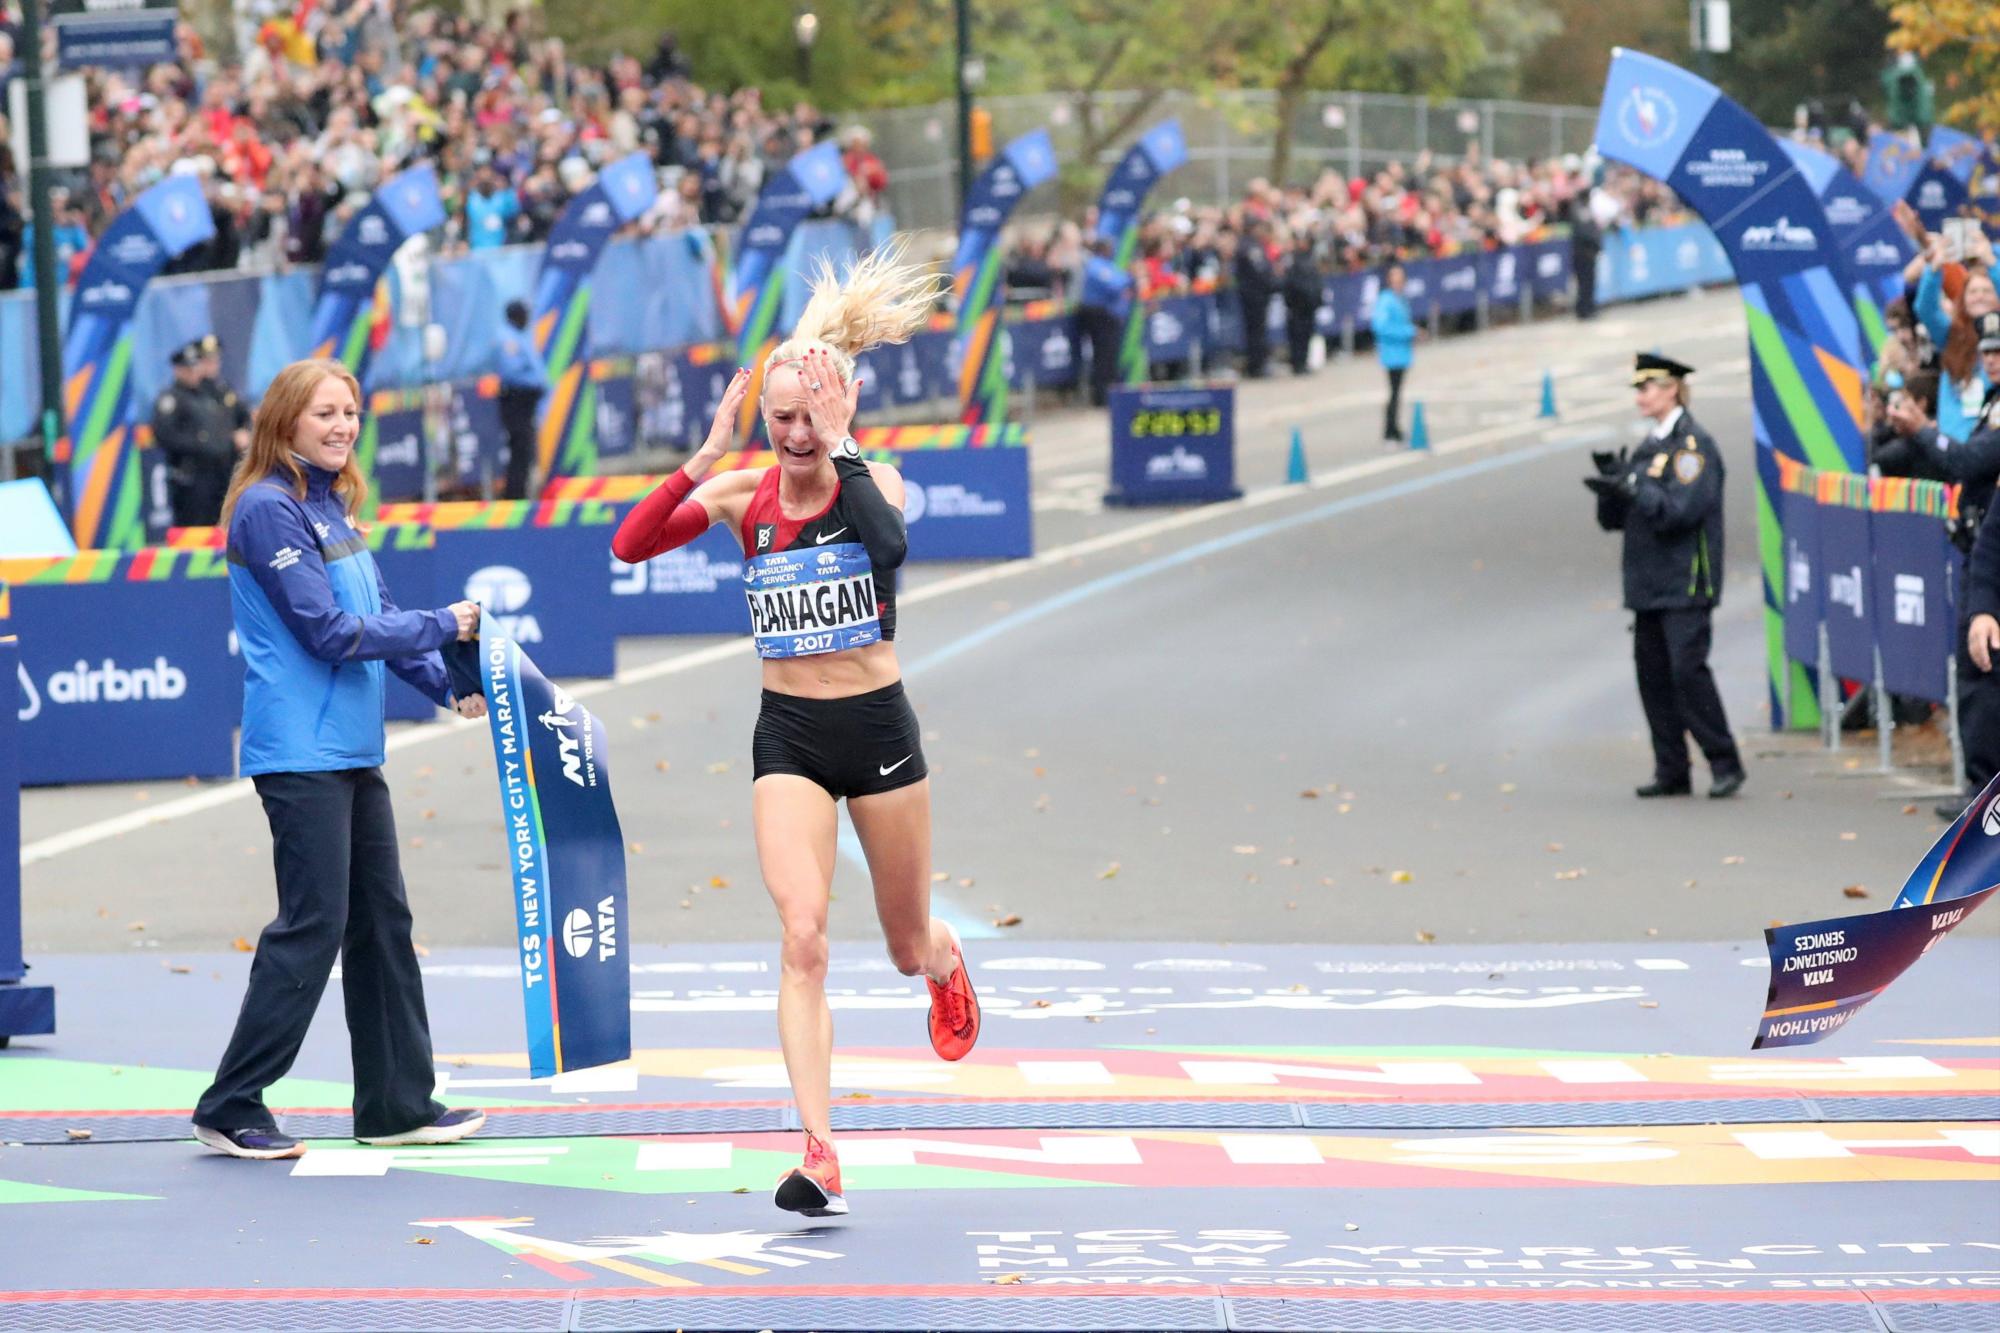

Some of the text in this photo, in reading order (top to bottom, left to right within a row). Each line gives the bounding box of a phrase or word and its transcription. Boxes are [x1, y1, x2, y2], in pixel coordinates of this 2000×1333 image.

[764, 556, 788, 566] TATA
[816, 565, 841, 575] TATA
[762, 573, 796, 585] SERVICES
[748, 578, 875, 633] FLANAGAN
[793, 634, 834, 651] 2017
[47, 655, 187, 704] airbnb
[583, 730, 594, 762] YORK
[588, 762, 597, 787] NEW
[489, 637, 543, 988] TCS NEW YORK CITY MARATHON
[597, 895, 616, 962] TATA
[1931, 907, 1964, 931] TATA
[1795, 930, 1845, 952] SERVICES
[1782, 946, 1858, 973] CONSULTANCY
[1803, 969, 1834, 987] TATA
[1767, 1009, 1850, 1039] MARATHON
[965, 1229, 1292, 1242] TCS
[976, 1243, 1288, 1255] NEW
[1324, 1245, 1701, 1256] YORK
[978, 1256, 1757, 1270] MARATHON
[1228, 1277, 1748, 1289] CONSULTANCY
